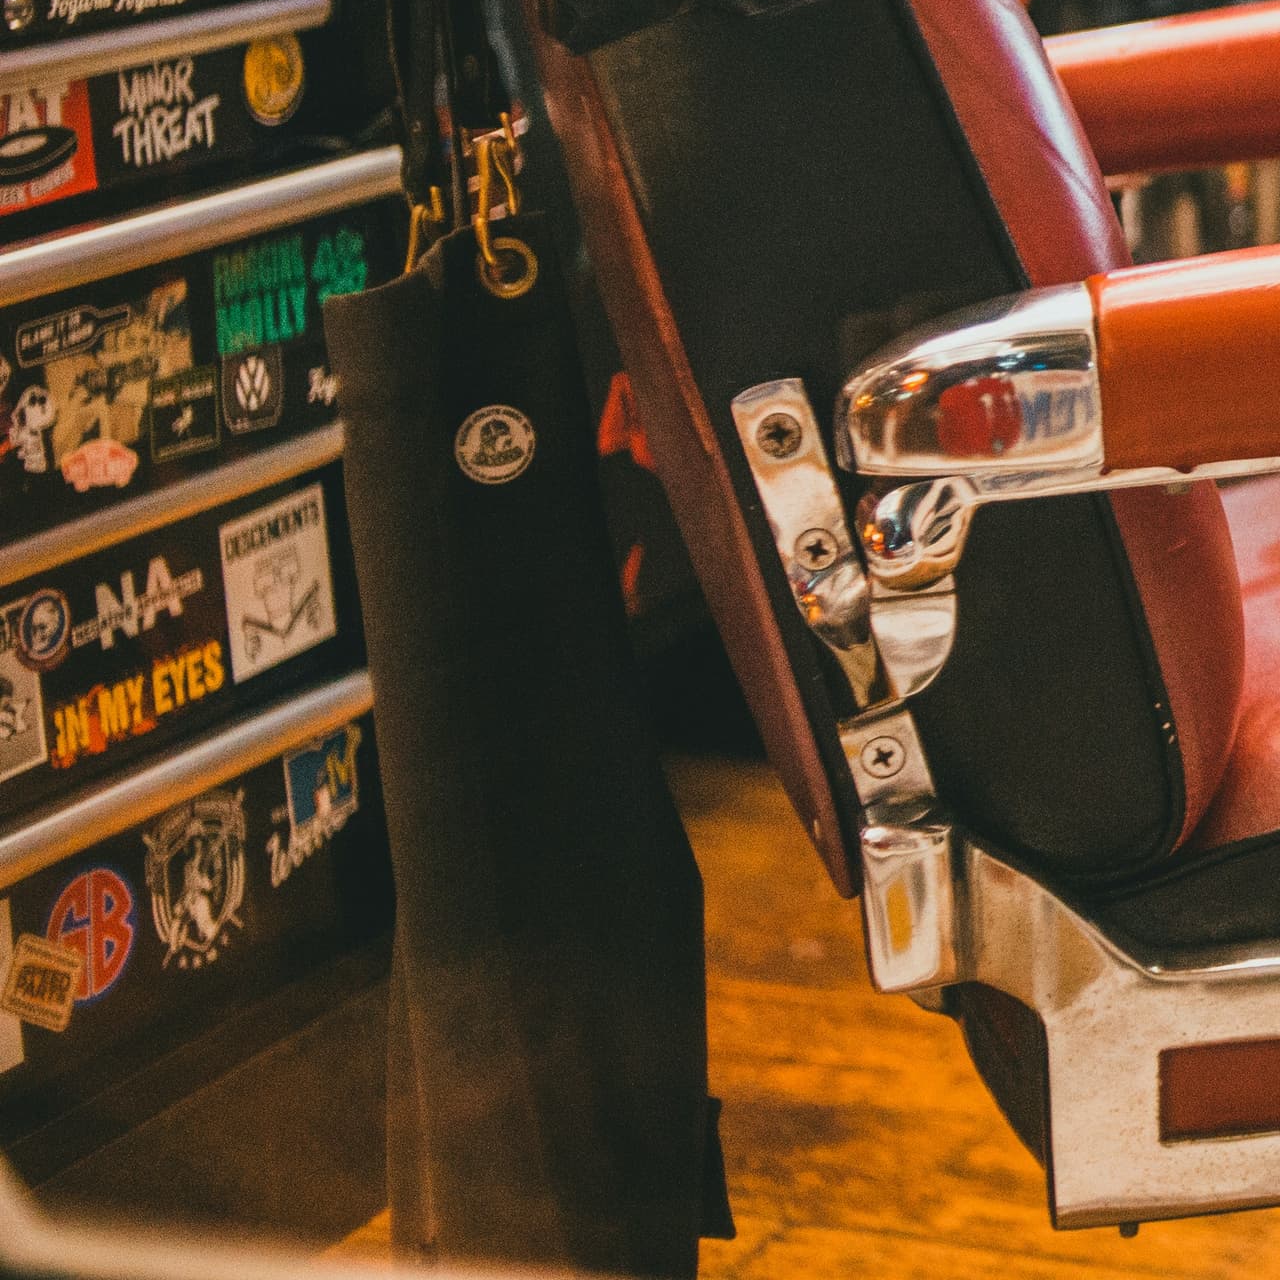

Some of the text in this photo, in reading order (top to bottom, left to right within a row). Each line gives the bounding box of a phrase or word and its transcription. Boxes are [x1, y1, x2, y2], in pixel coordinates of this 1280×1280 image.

[118, 56, 195, 118] MINOR
[112, 94, 220, 167] THREAT
[53, 640, 225, 761] IN MY EYES
